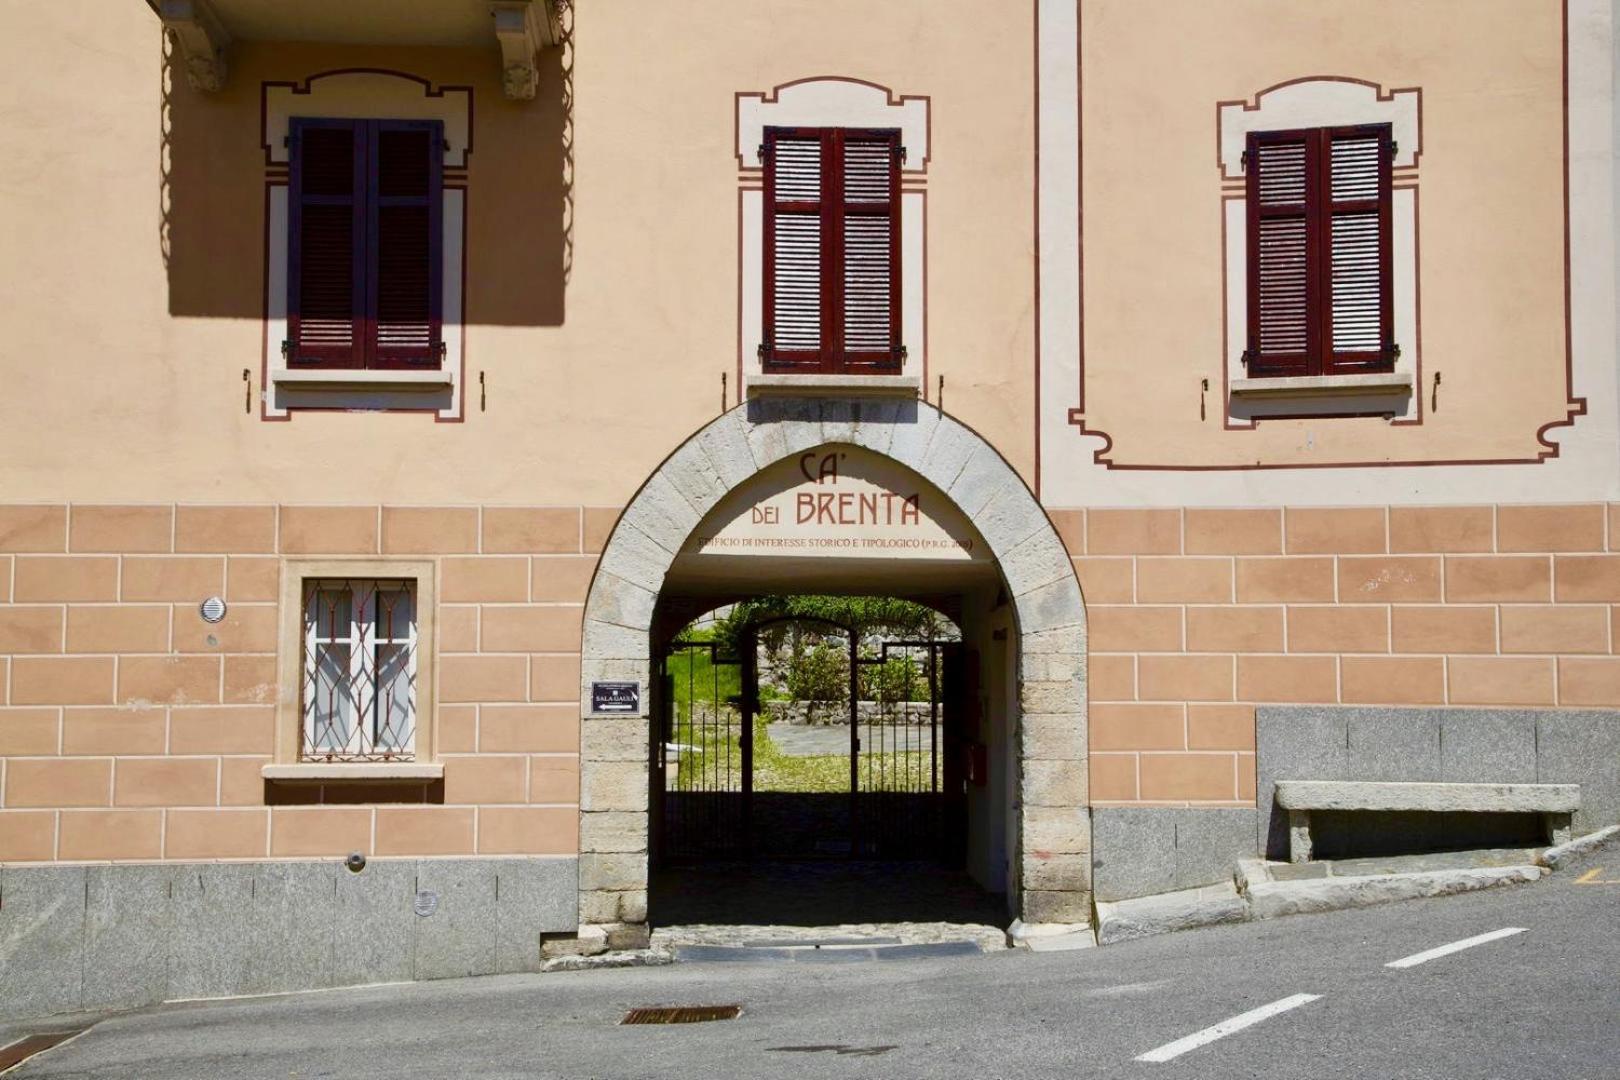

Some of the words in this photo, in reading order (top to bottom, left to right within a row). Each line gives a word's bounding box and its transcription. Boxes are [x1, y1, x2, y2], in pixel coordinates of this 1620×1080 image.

[800, 452, 846, 485] CA'
[752, 506, 779, 525] DEI
[796, 492, 919, 525] BRENTA
[743, 538, 753, 547] DI
[755, 538, 807, 548] INTERESSE
[809, 538, 850, 548] STORICO
[853, 539, 859, 548] E
[861, 538, 919, 549] TIPOLOGICO
